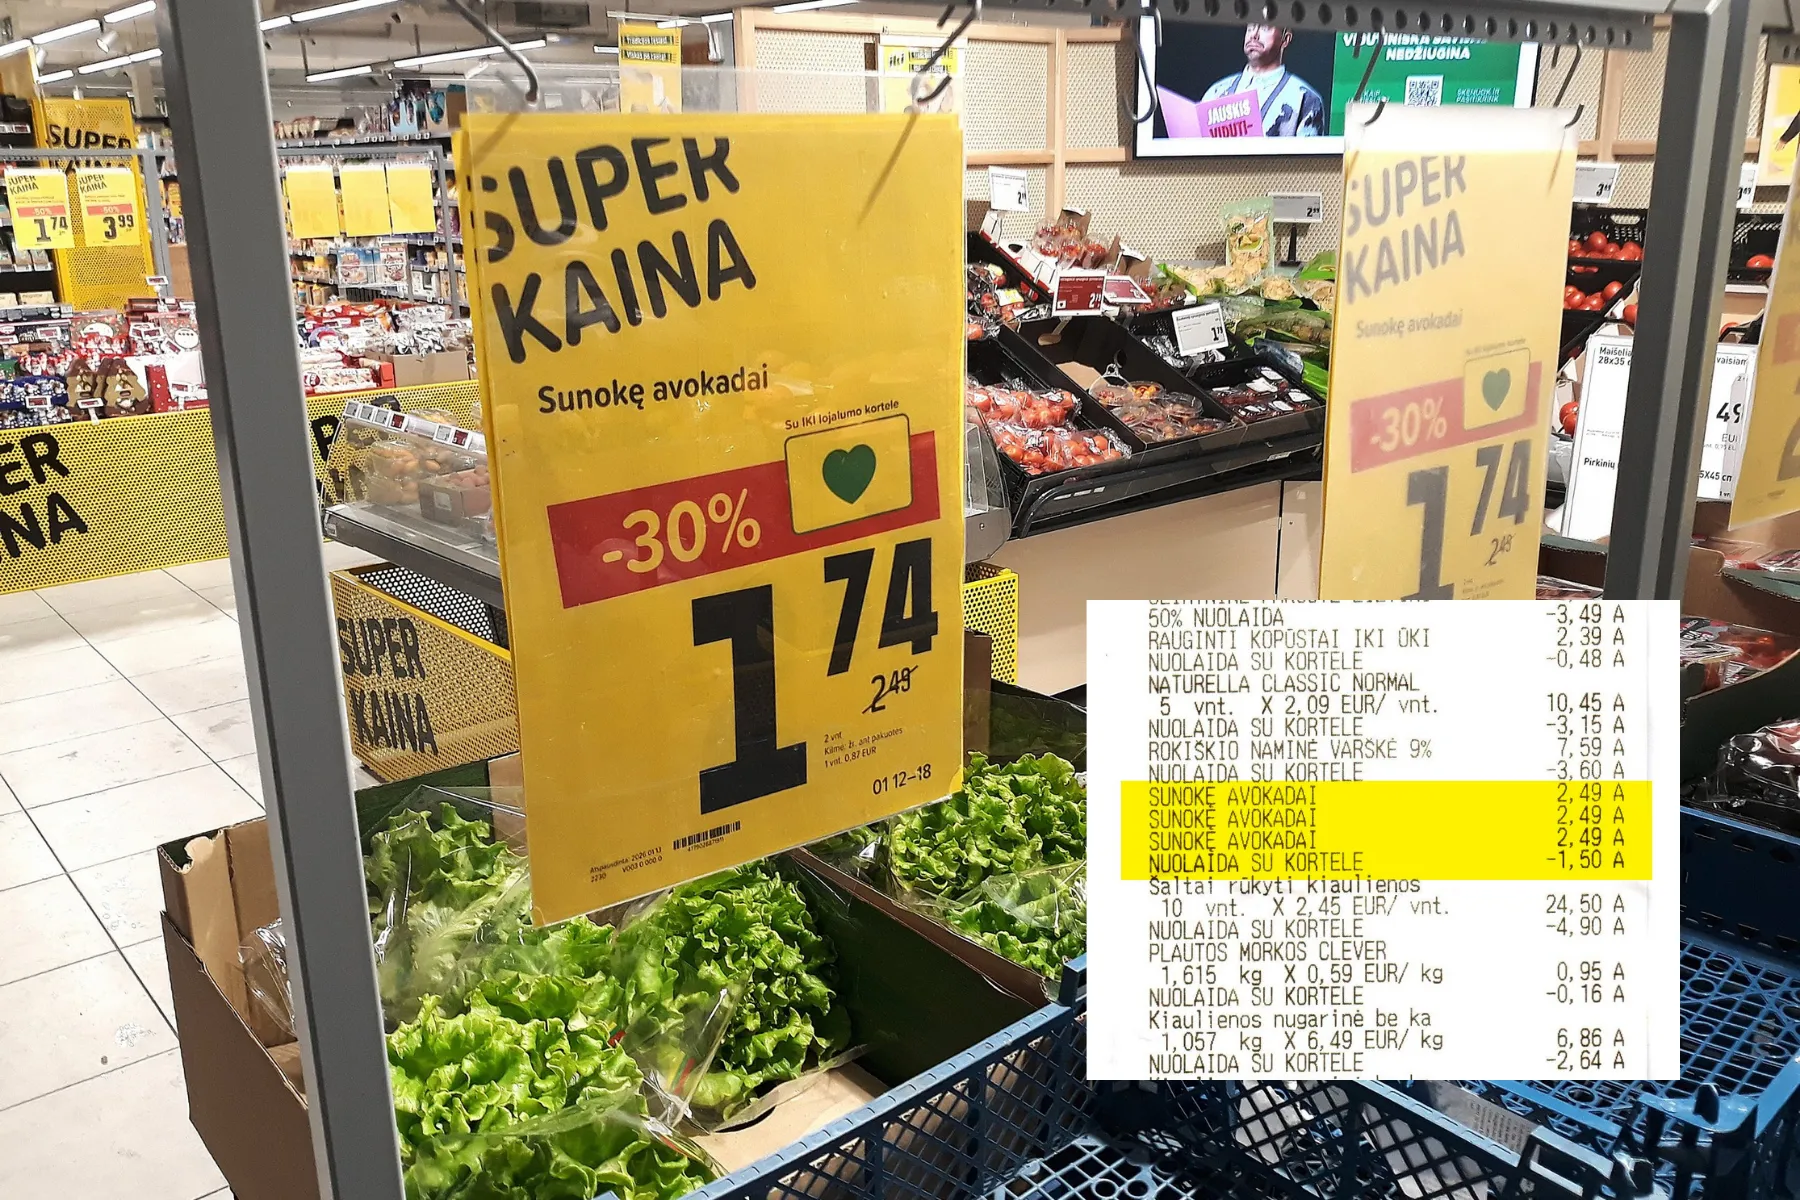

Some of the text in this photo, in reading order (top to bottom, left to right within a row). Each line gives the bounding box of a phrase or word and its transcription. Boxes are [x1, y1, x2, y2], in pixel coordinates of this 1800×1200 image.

[1385, 45, 1471, 61] NEDŽIUGINA
[1207, 99, 1251, 126] JAUSKIS
[1345, 209, 1465, 304] KAINA
[491, 219, 756, 364] KAINA
[1356, 309, 1463, 339] Sunokę avokadai
[1598, 356, 1625, 366] 28x35
[539, 363, 768, 413] Sunokę avokadai
[785, 400, 899, 430] Su IKI lojalumo kortele
[1370, 396, 1447, 452] -30%
[1584, 457, 1615, 470] Pirkinių
[602, 488, 761, 574] -30%
[337, 618, 425, 680] SUPER
[691, 538, 939, 815] 1 74
[350, 689, 438, 755] KAINA
[824, 733, 829, 743] 2
[859, 735, 870, 746] ant
[862, 746, 877, 758] EUR
